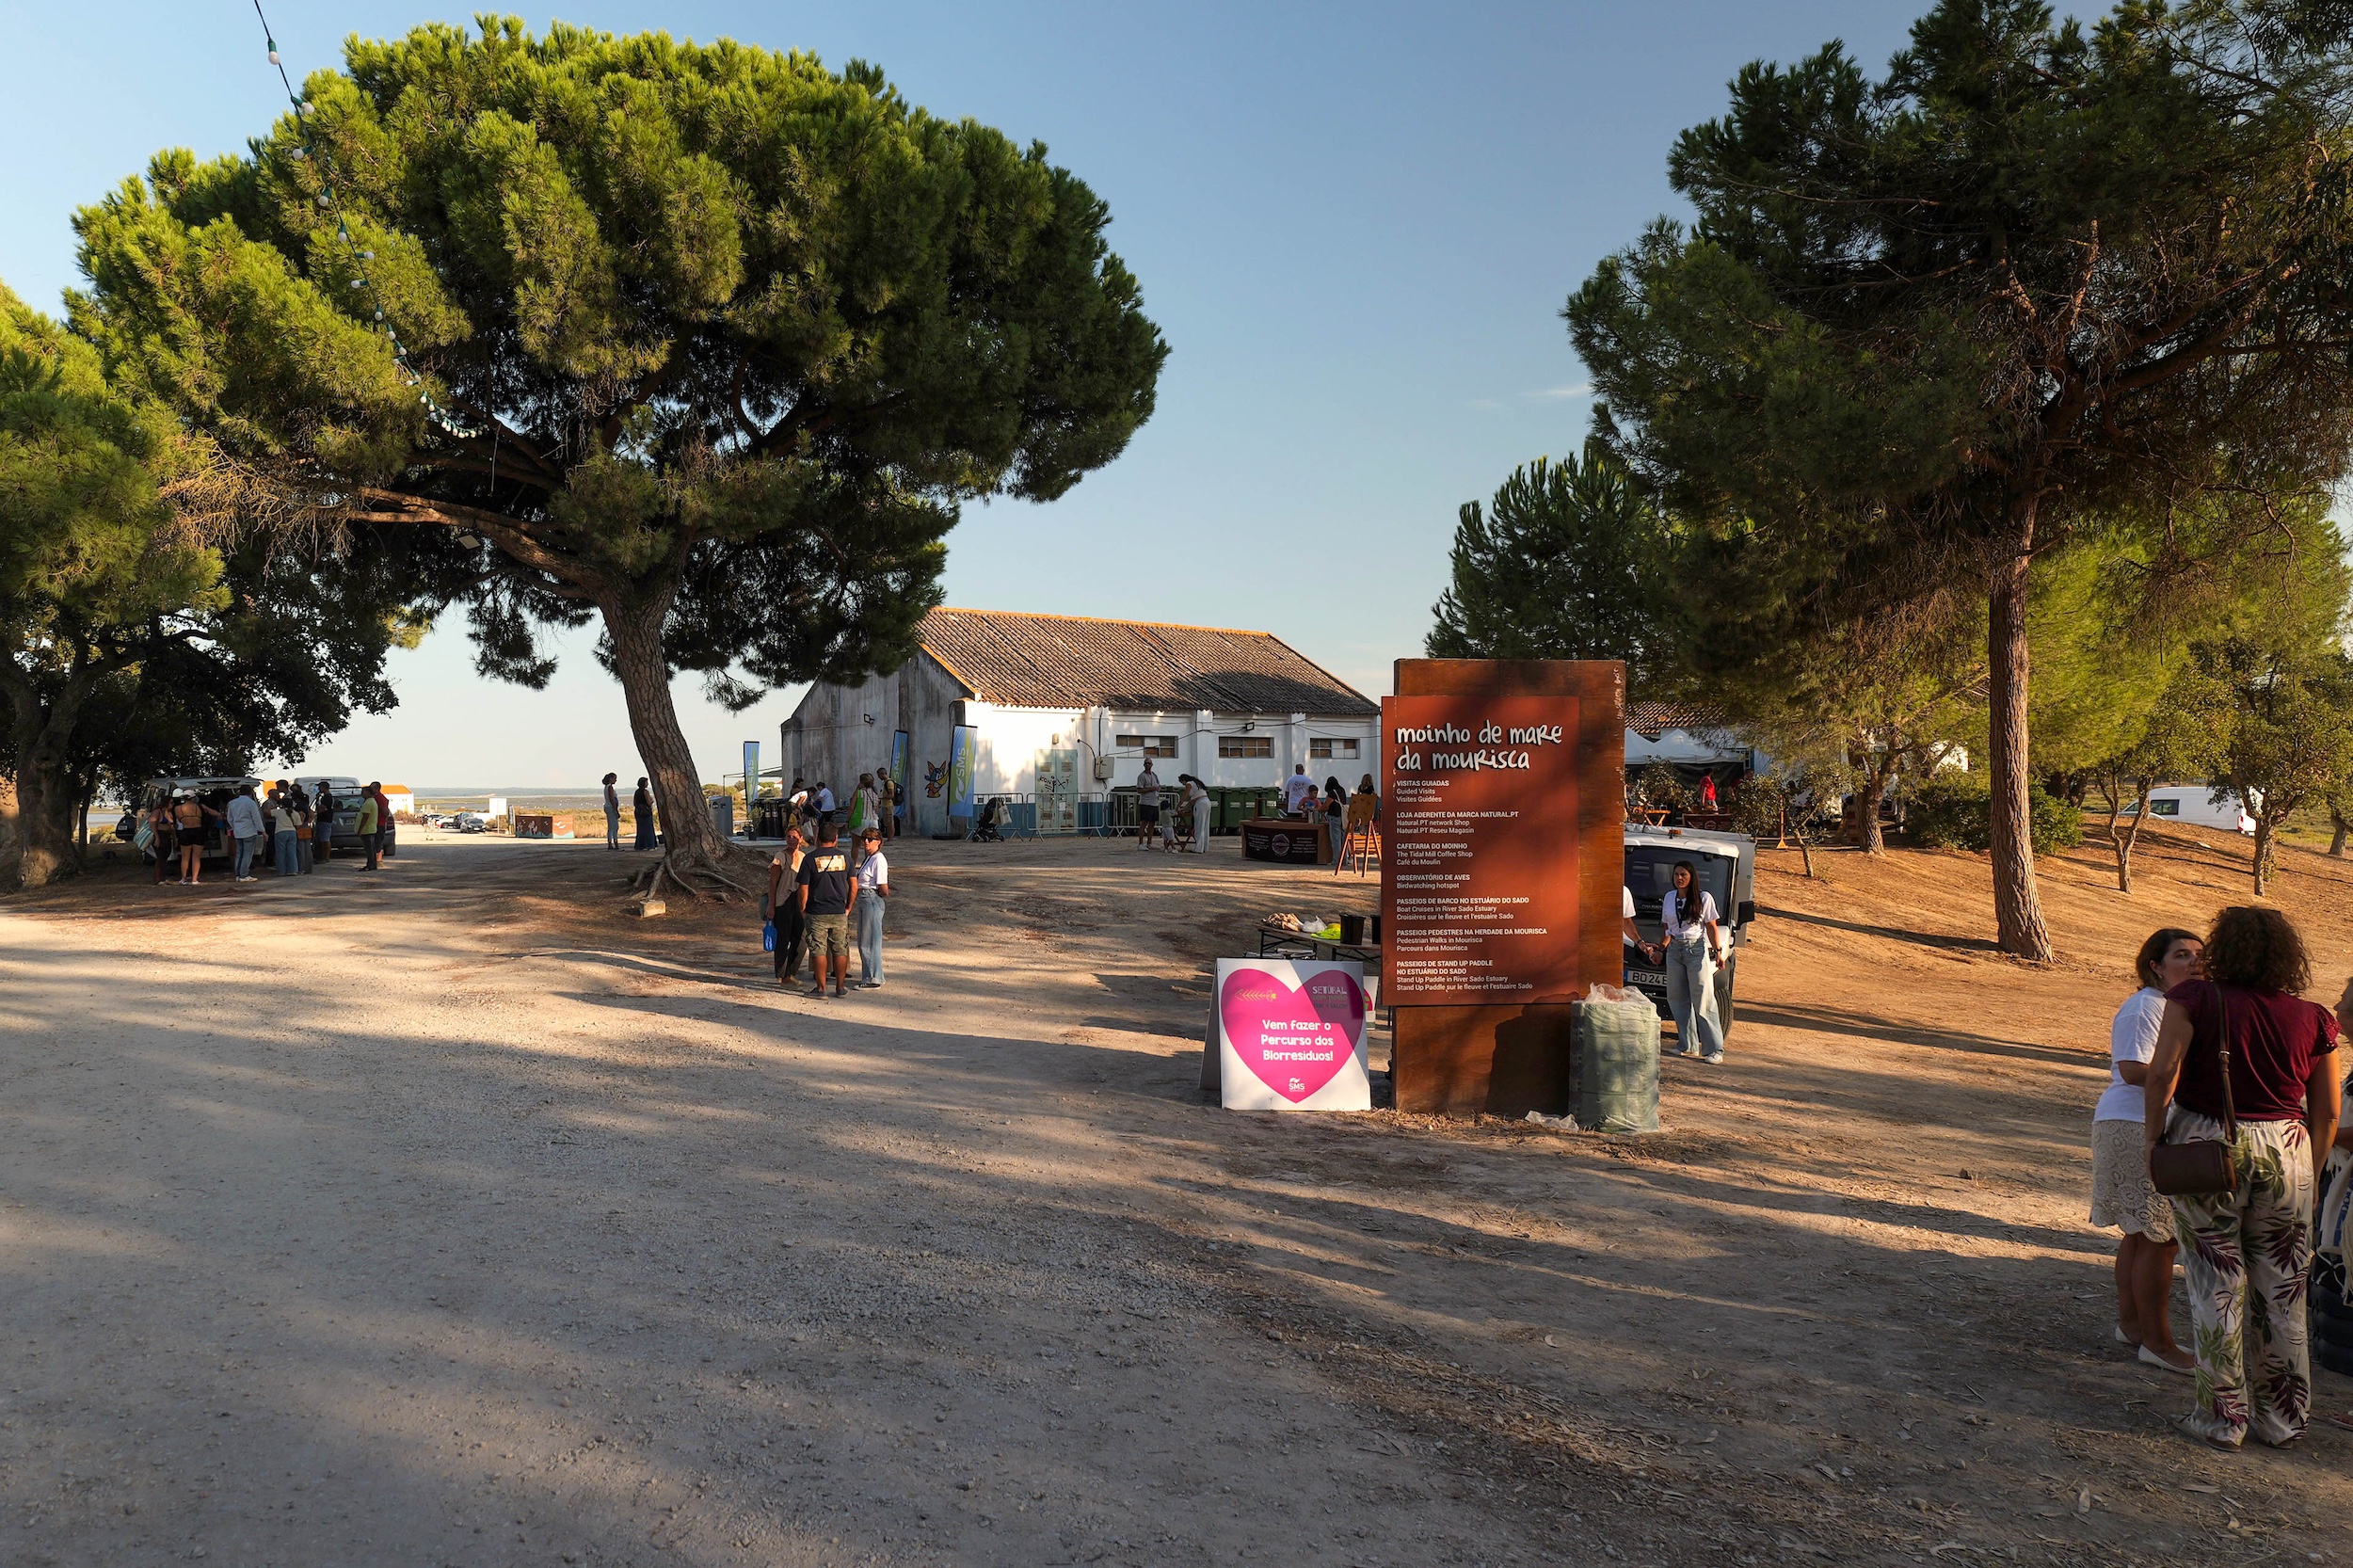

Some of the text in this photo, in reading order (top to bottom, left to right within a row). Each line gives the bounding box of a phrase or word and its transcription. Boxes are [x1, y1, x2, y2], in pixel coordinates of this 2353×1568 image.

[1398, 723, 1470, 744] moinho
[1479, 719, 1502, 744] de
[956, 747, 966, 777] SMS
[1397, 745, 1421, 770] da
[1632, 972, 1647, 983] BD
[1649, 974, 1660, 984] 24
[1262, 1019, 1331, 1031] Vem fazer o
[1261, 1034, 1334, 1046] Percurso dos
